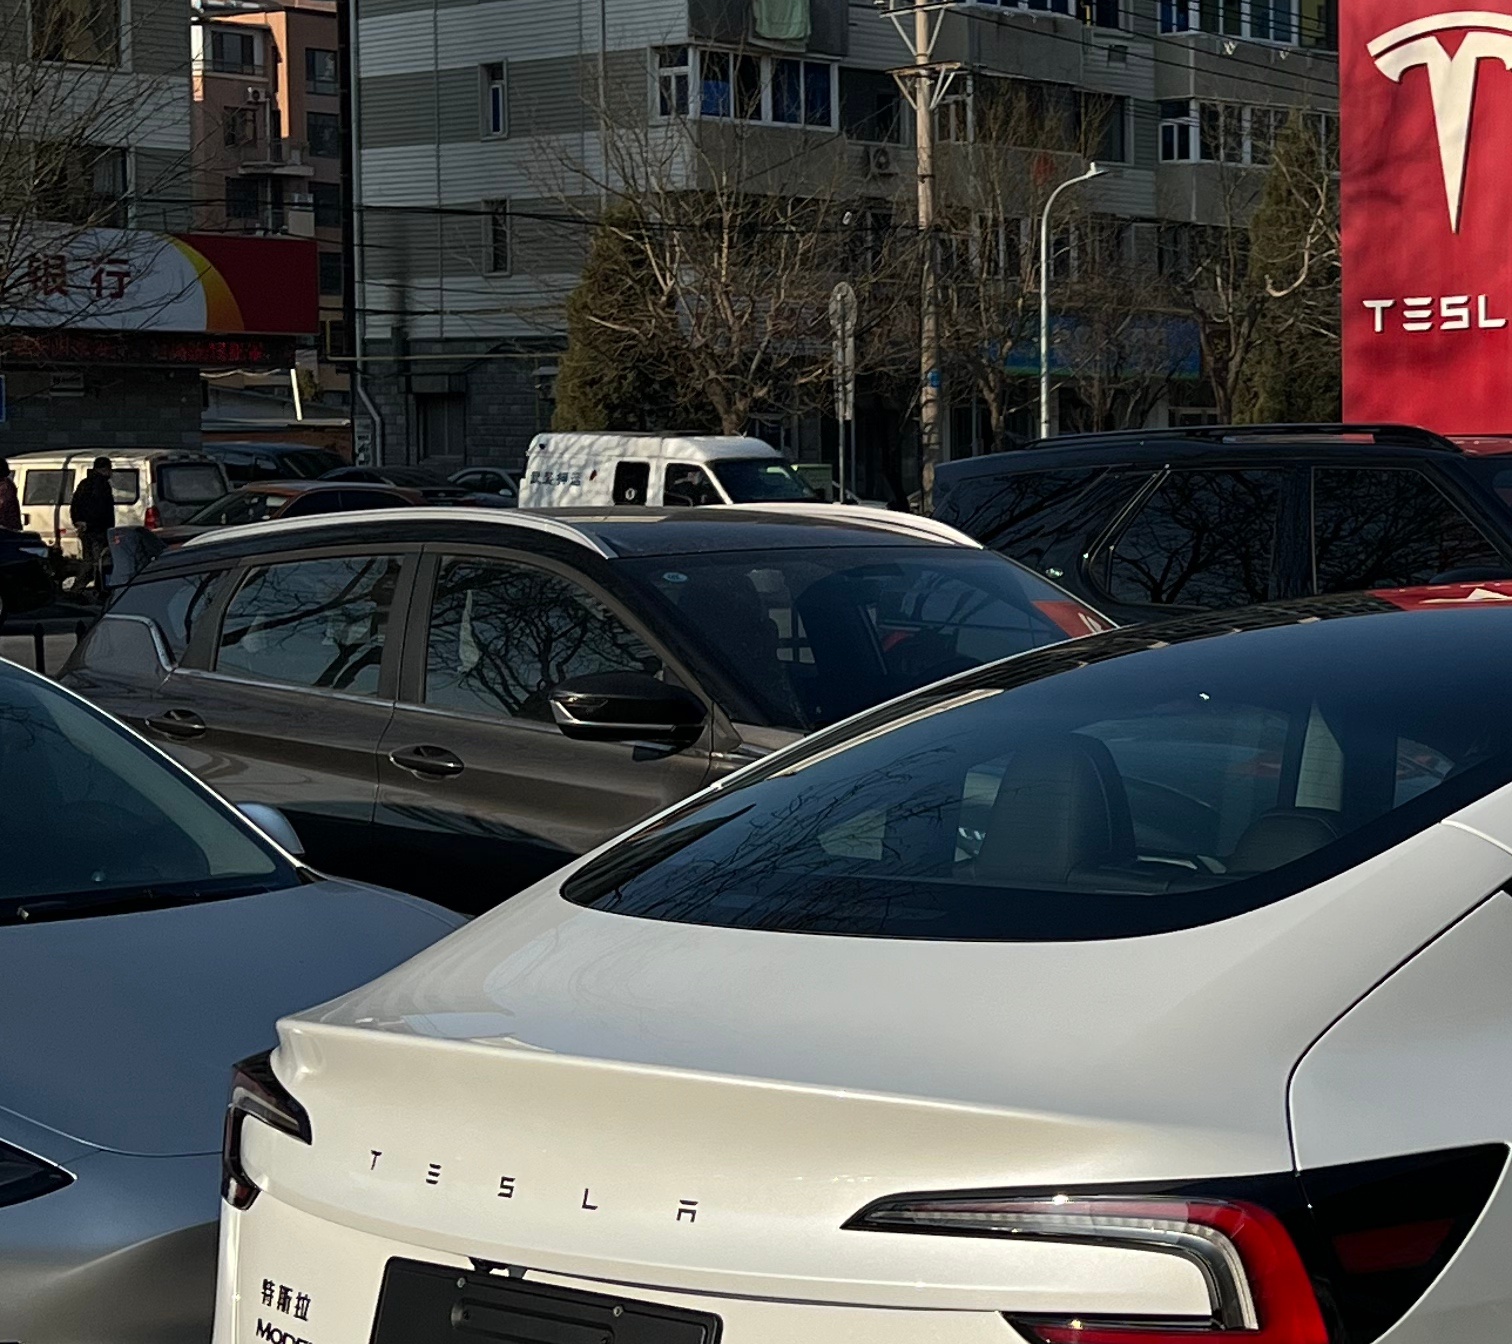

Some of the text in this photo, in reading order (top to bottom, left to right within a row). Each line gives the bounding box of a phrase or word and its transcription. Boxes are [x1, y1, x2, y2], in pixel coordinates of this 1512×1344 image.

[369, 1149, 699, 1223] TESLA
[261, 1278, 311, 1322] 特斯拉
